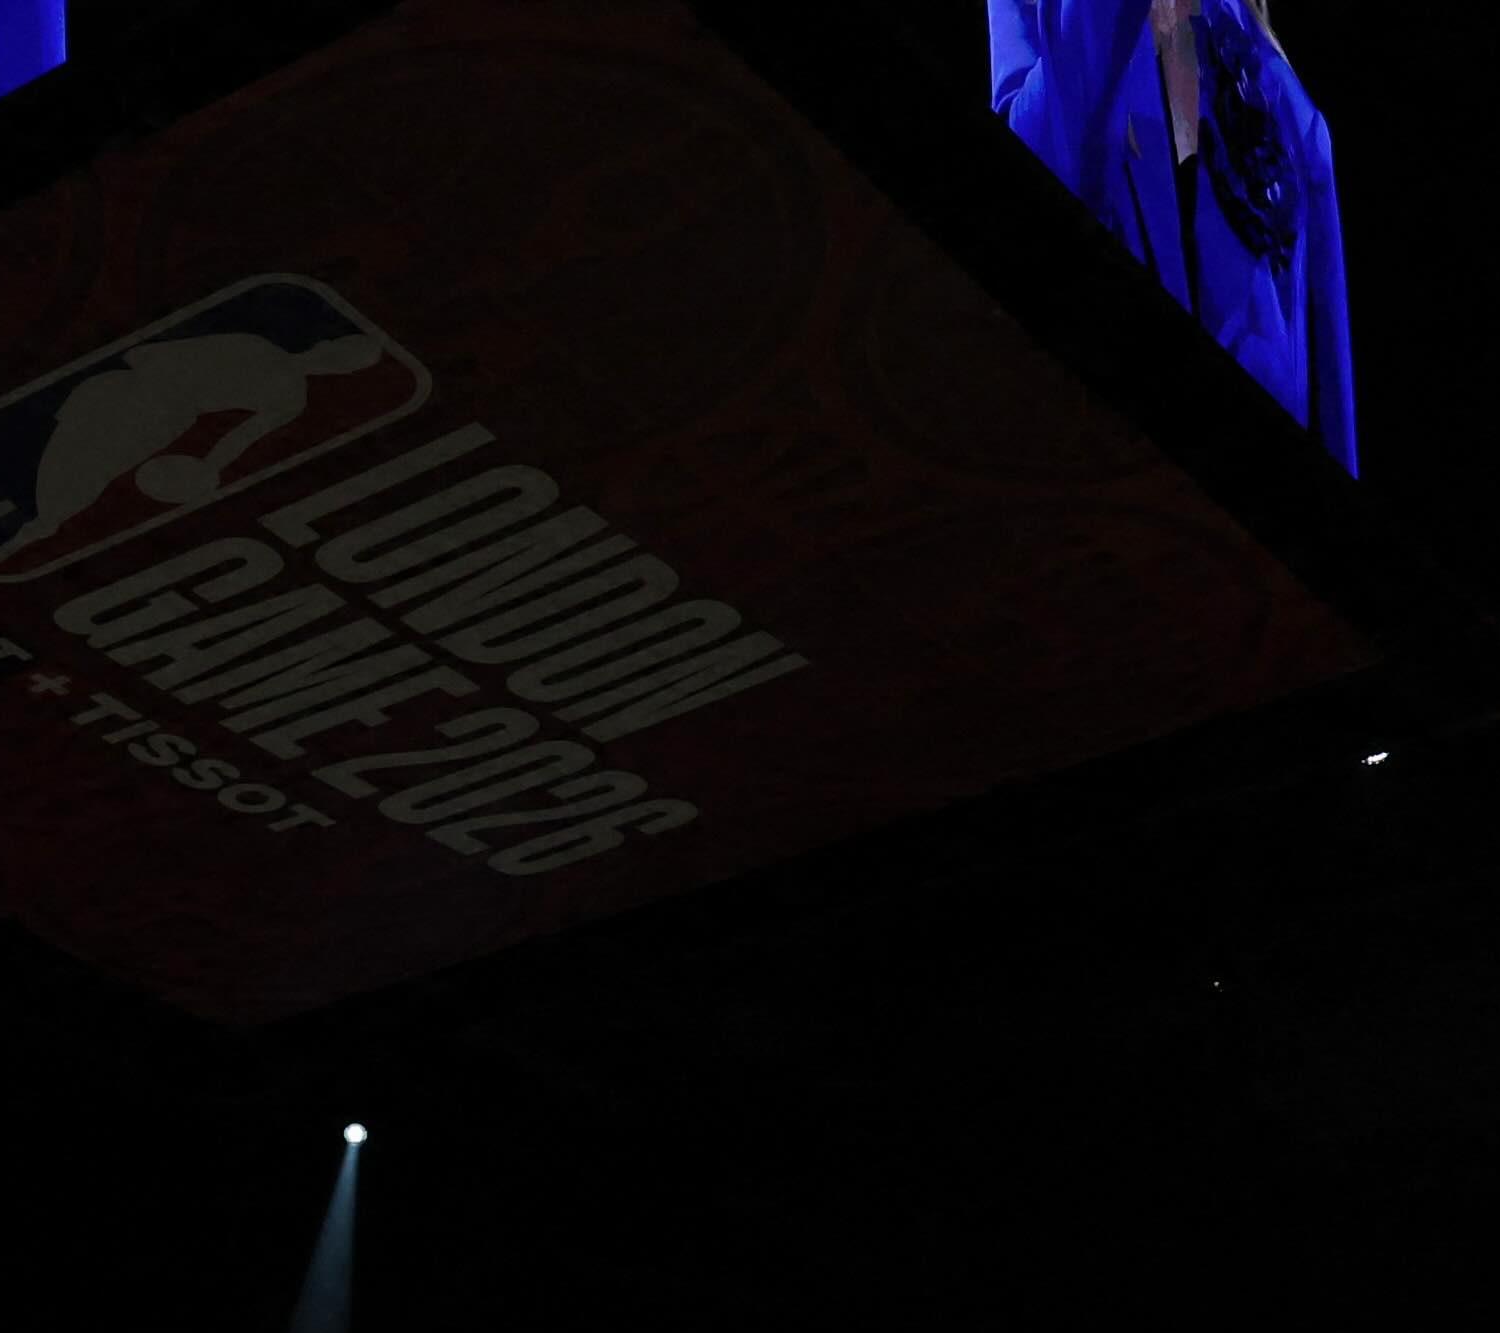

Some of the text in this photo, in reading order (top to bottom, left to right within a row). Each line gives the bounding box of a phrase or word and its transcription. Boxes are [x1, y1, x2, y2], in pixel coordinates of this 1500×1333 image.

[52, 536, 700, 878] GAME 2026
[259, 422, 811, 743] LONDON
[69, 691, 337, 834] TISSOT
